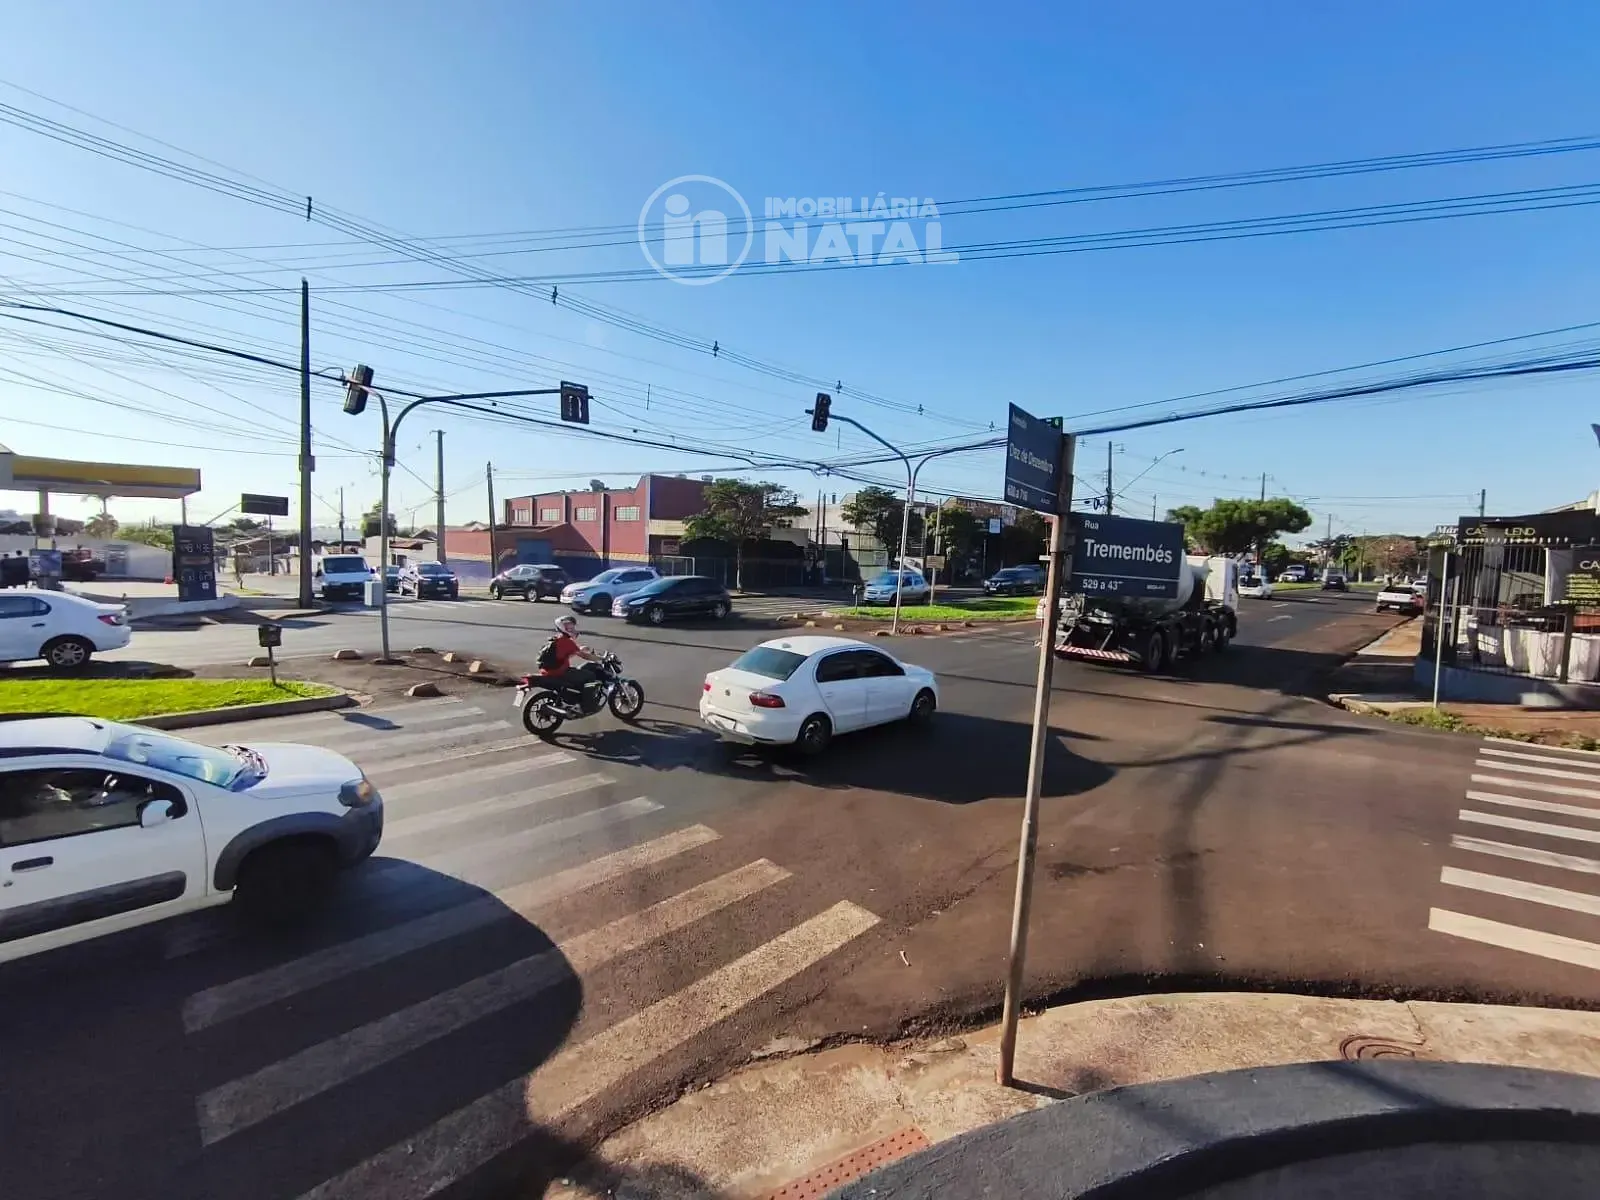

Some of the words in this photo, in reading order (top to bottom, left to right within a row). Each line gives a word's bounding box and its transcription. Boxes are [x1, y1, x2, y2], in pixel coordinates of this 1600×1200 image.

[1084, 519, 1100, 530] Rua
[1465, 527, 1488, 536] CAS
[1504, 527, 1536, 536] LEND
[1083, 538, 1173, 564] Tremembés
[1580, 560, 1600, 570] CA
[1082, 578, 1099, 589] 529
[1100, 581, 1106, 590] a
